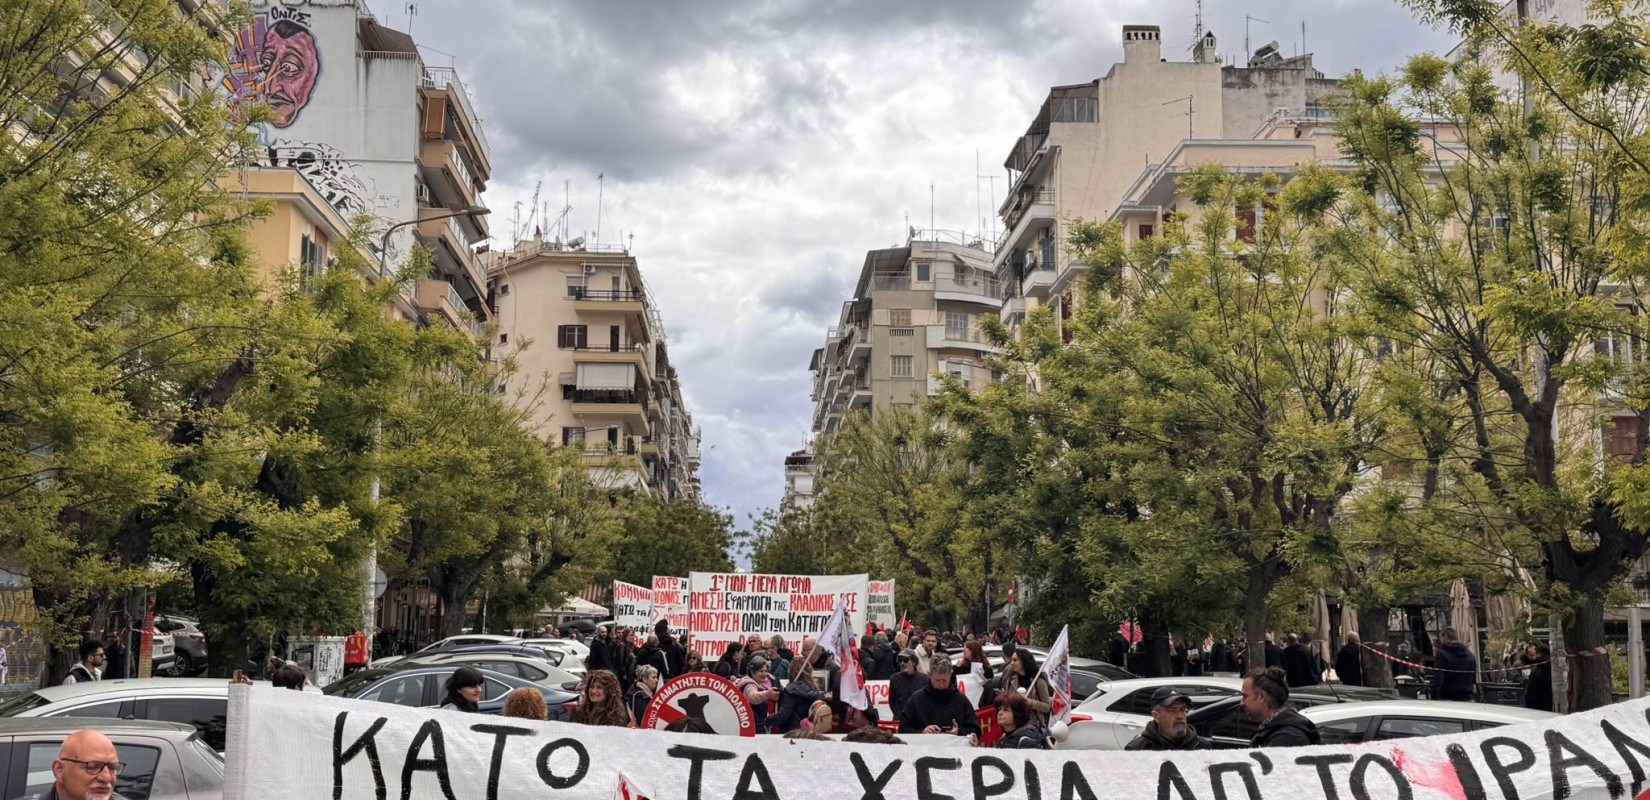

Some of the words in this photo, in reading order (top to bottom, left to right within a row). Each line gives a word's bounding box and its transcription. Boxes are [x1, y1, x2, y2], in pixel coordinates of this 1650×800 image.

[655, 577, 678, 590] ΚΑΤΩ
[779, 576, 811, 593] ΑΓΩΝΑ
[690, 592, 724, 610] ΑΜΕΣΗ
[790, 594, 835, 612] ΚΛΑΔΙΚΗΣ
[689, 612, 740, 632] ΑΠΟΣΥΡΣΗ
[742, 613, 768, 632] ΟΛΩΝ
[770, 618, 786, 632] ΤΩΝ
[788, 612, 831, 632] ΚΑΤΗΓΟ
[652, 676, 706, 710] ΣΤΑΜΑΤΗΣΤΕ
[709, 678, 728, 694] ΤΟΝ
[726, 690, 751, 728] ΠΟΛΕΜΟ
[332, 711, 590, 800] ΚΑΤΟ
